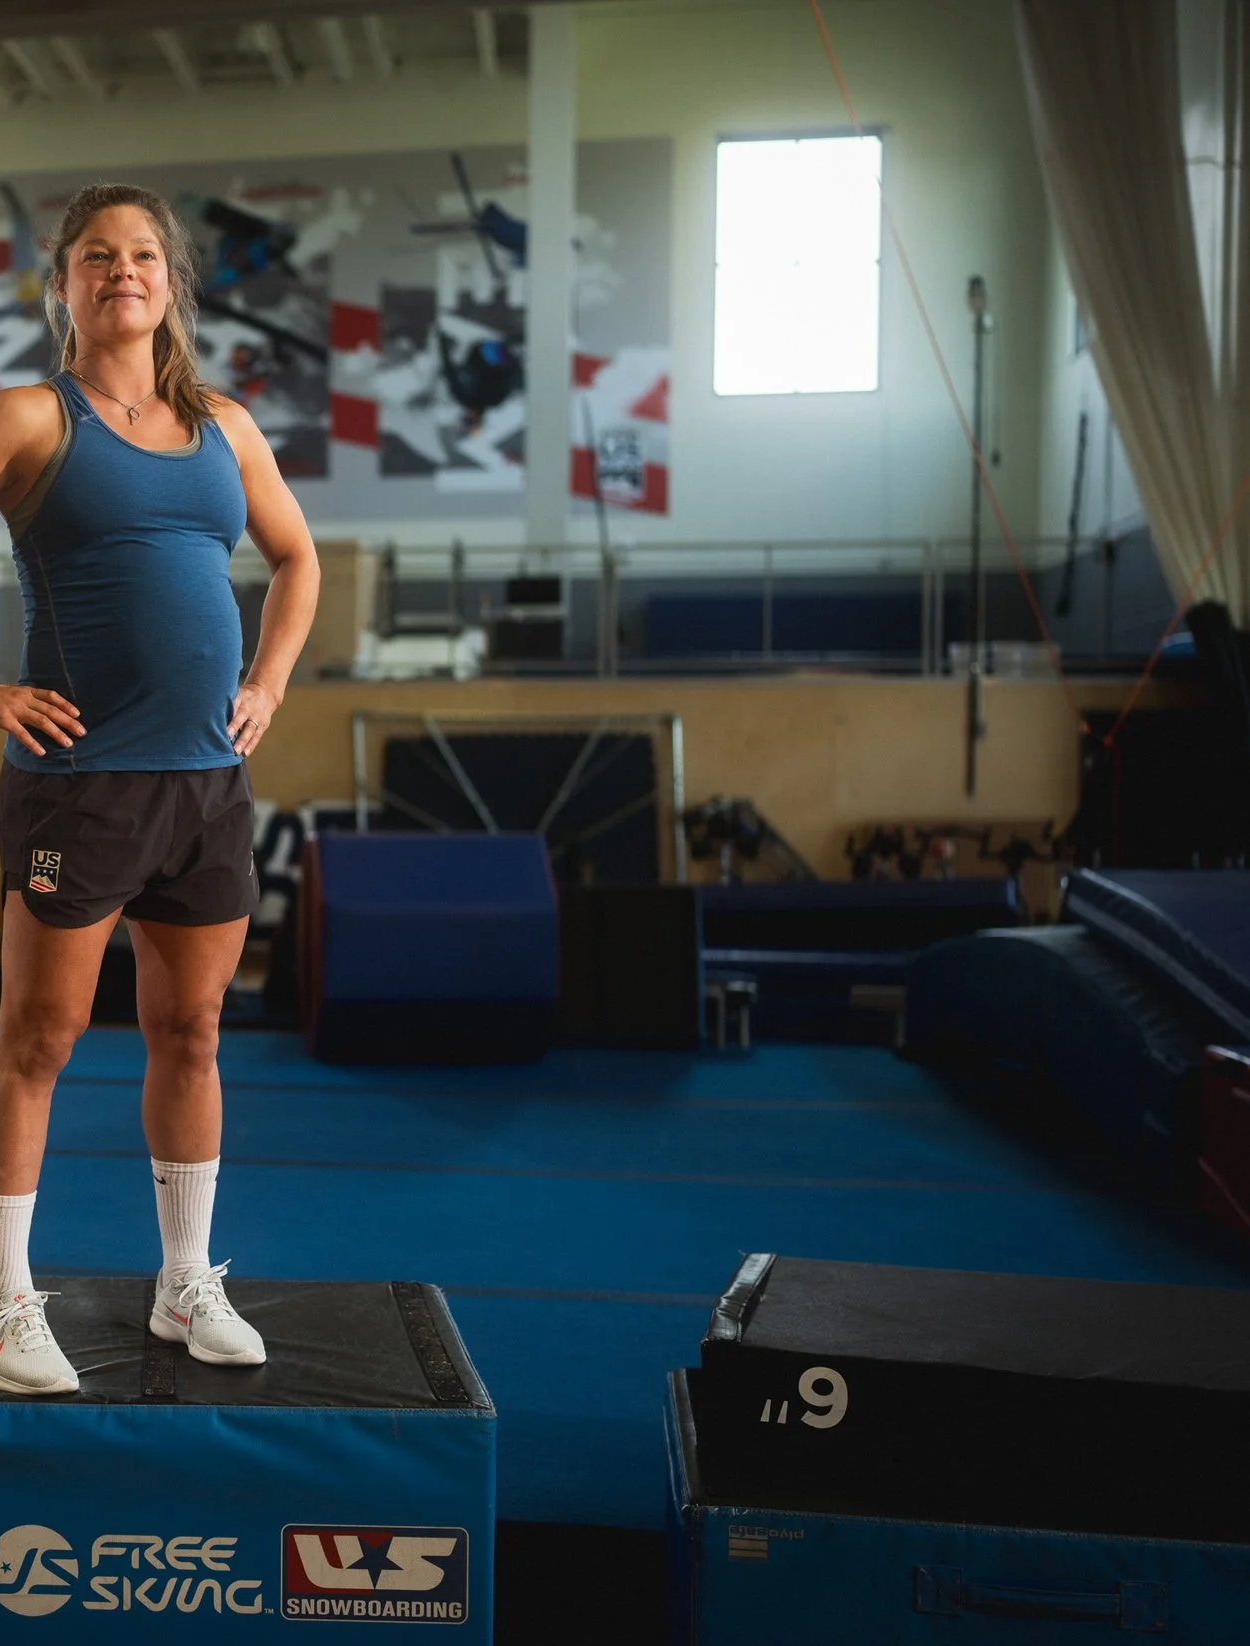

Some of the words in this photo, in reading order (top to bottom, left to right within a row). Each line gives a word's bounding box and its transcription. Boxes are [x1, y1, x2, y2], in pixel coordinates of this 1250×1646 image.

[34, 850, 59, 867] US
[91, 1534, 239, 1572] FREE
[293, 1534, 458, 1591] US
[82, 1575, 263, 1615] SKIING
[286, 1598, 463, 1618] SNOWBOARDING
